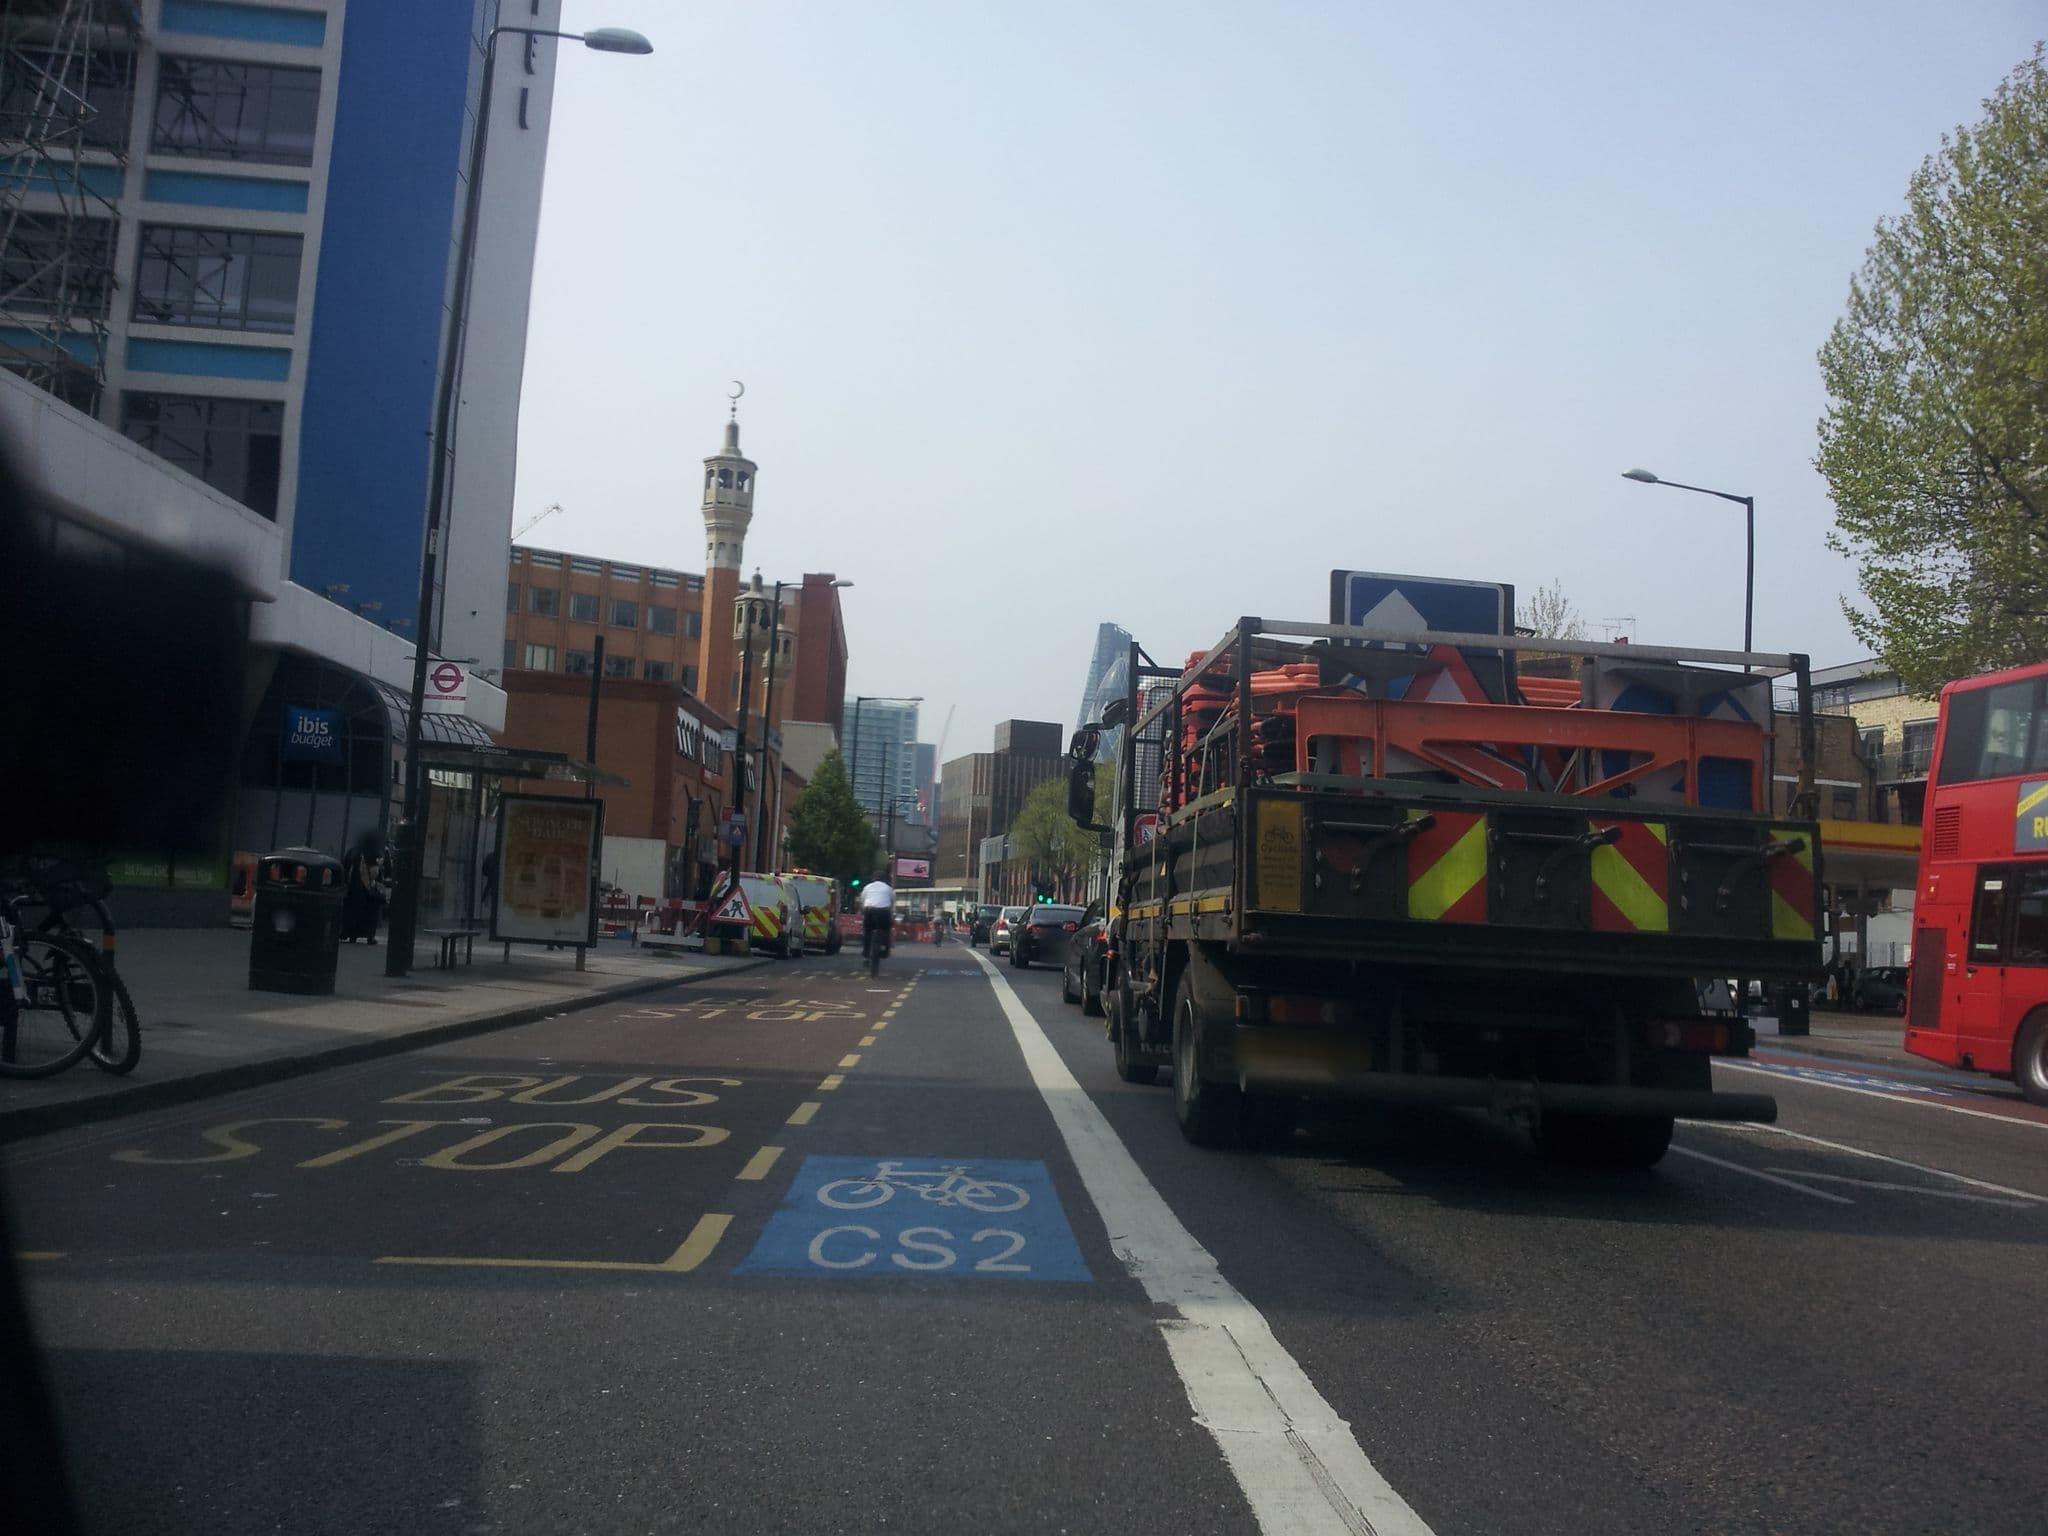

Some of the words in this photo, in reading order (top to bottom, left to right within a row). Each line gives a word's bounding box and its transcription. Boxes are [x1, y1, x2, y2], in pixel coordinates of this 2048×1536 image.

[297, 716, 329, 735] ibis
[291, 732, 334, 748] budget
[615, 1009, 867, 1021] STOP
[382, 1074, 743, 1106] BUS
[111, 1118, 731, 1172] STOP
[808, 1225, 1032, 1271] CS2
